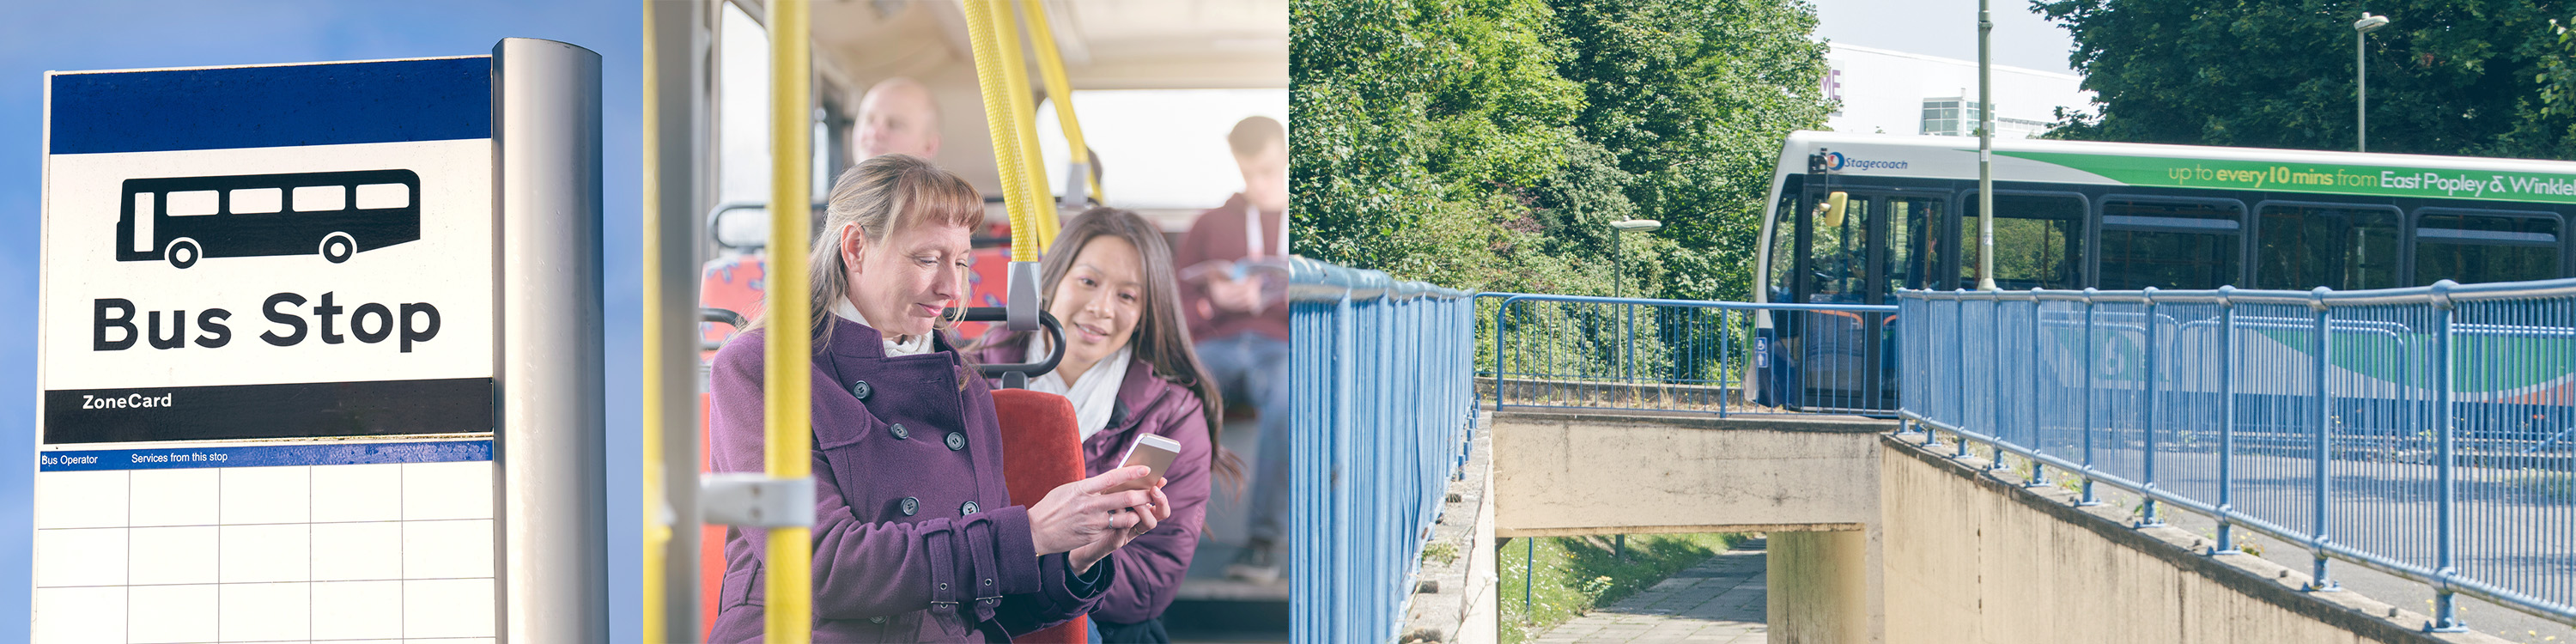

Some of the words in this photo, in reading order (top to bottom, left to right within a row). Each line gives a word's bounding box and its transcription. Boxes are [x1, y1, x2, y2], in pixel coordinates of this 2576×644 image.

[1844, 157, 1908, 171] Stagecoach
[2168, 167, 2190, 185] up
[2195, 164, 2214, 181] to
[2215, 168, 2268, 188] every
[2269, 167, 2290, 184] 10
[2292, 168, 2334, 185] mins
[2336, 169, 2378, 186] from
[2380, 171, 2421, 189] East
[2423, 172, 2487, 197] Popley
[2489, 175, 2506, 193] &
[93, 298, 233, 352] Bus
[259, 290, 441, 354] Stop
[82, 392, 172, 410] ZoneCard
[41, 455, 58, 465] Bus
[60, 455, 98, 466] Operator
[131, 453, 168, 464] Services
[170, 453, 190, 463] from
[191, 453, 207, 463] this
[210, 453, 228, 464] stop
